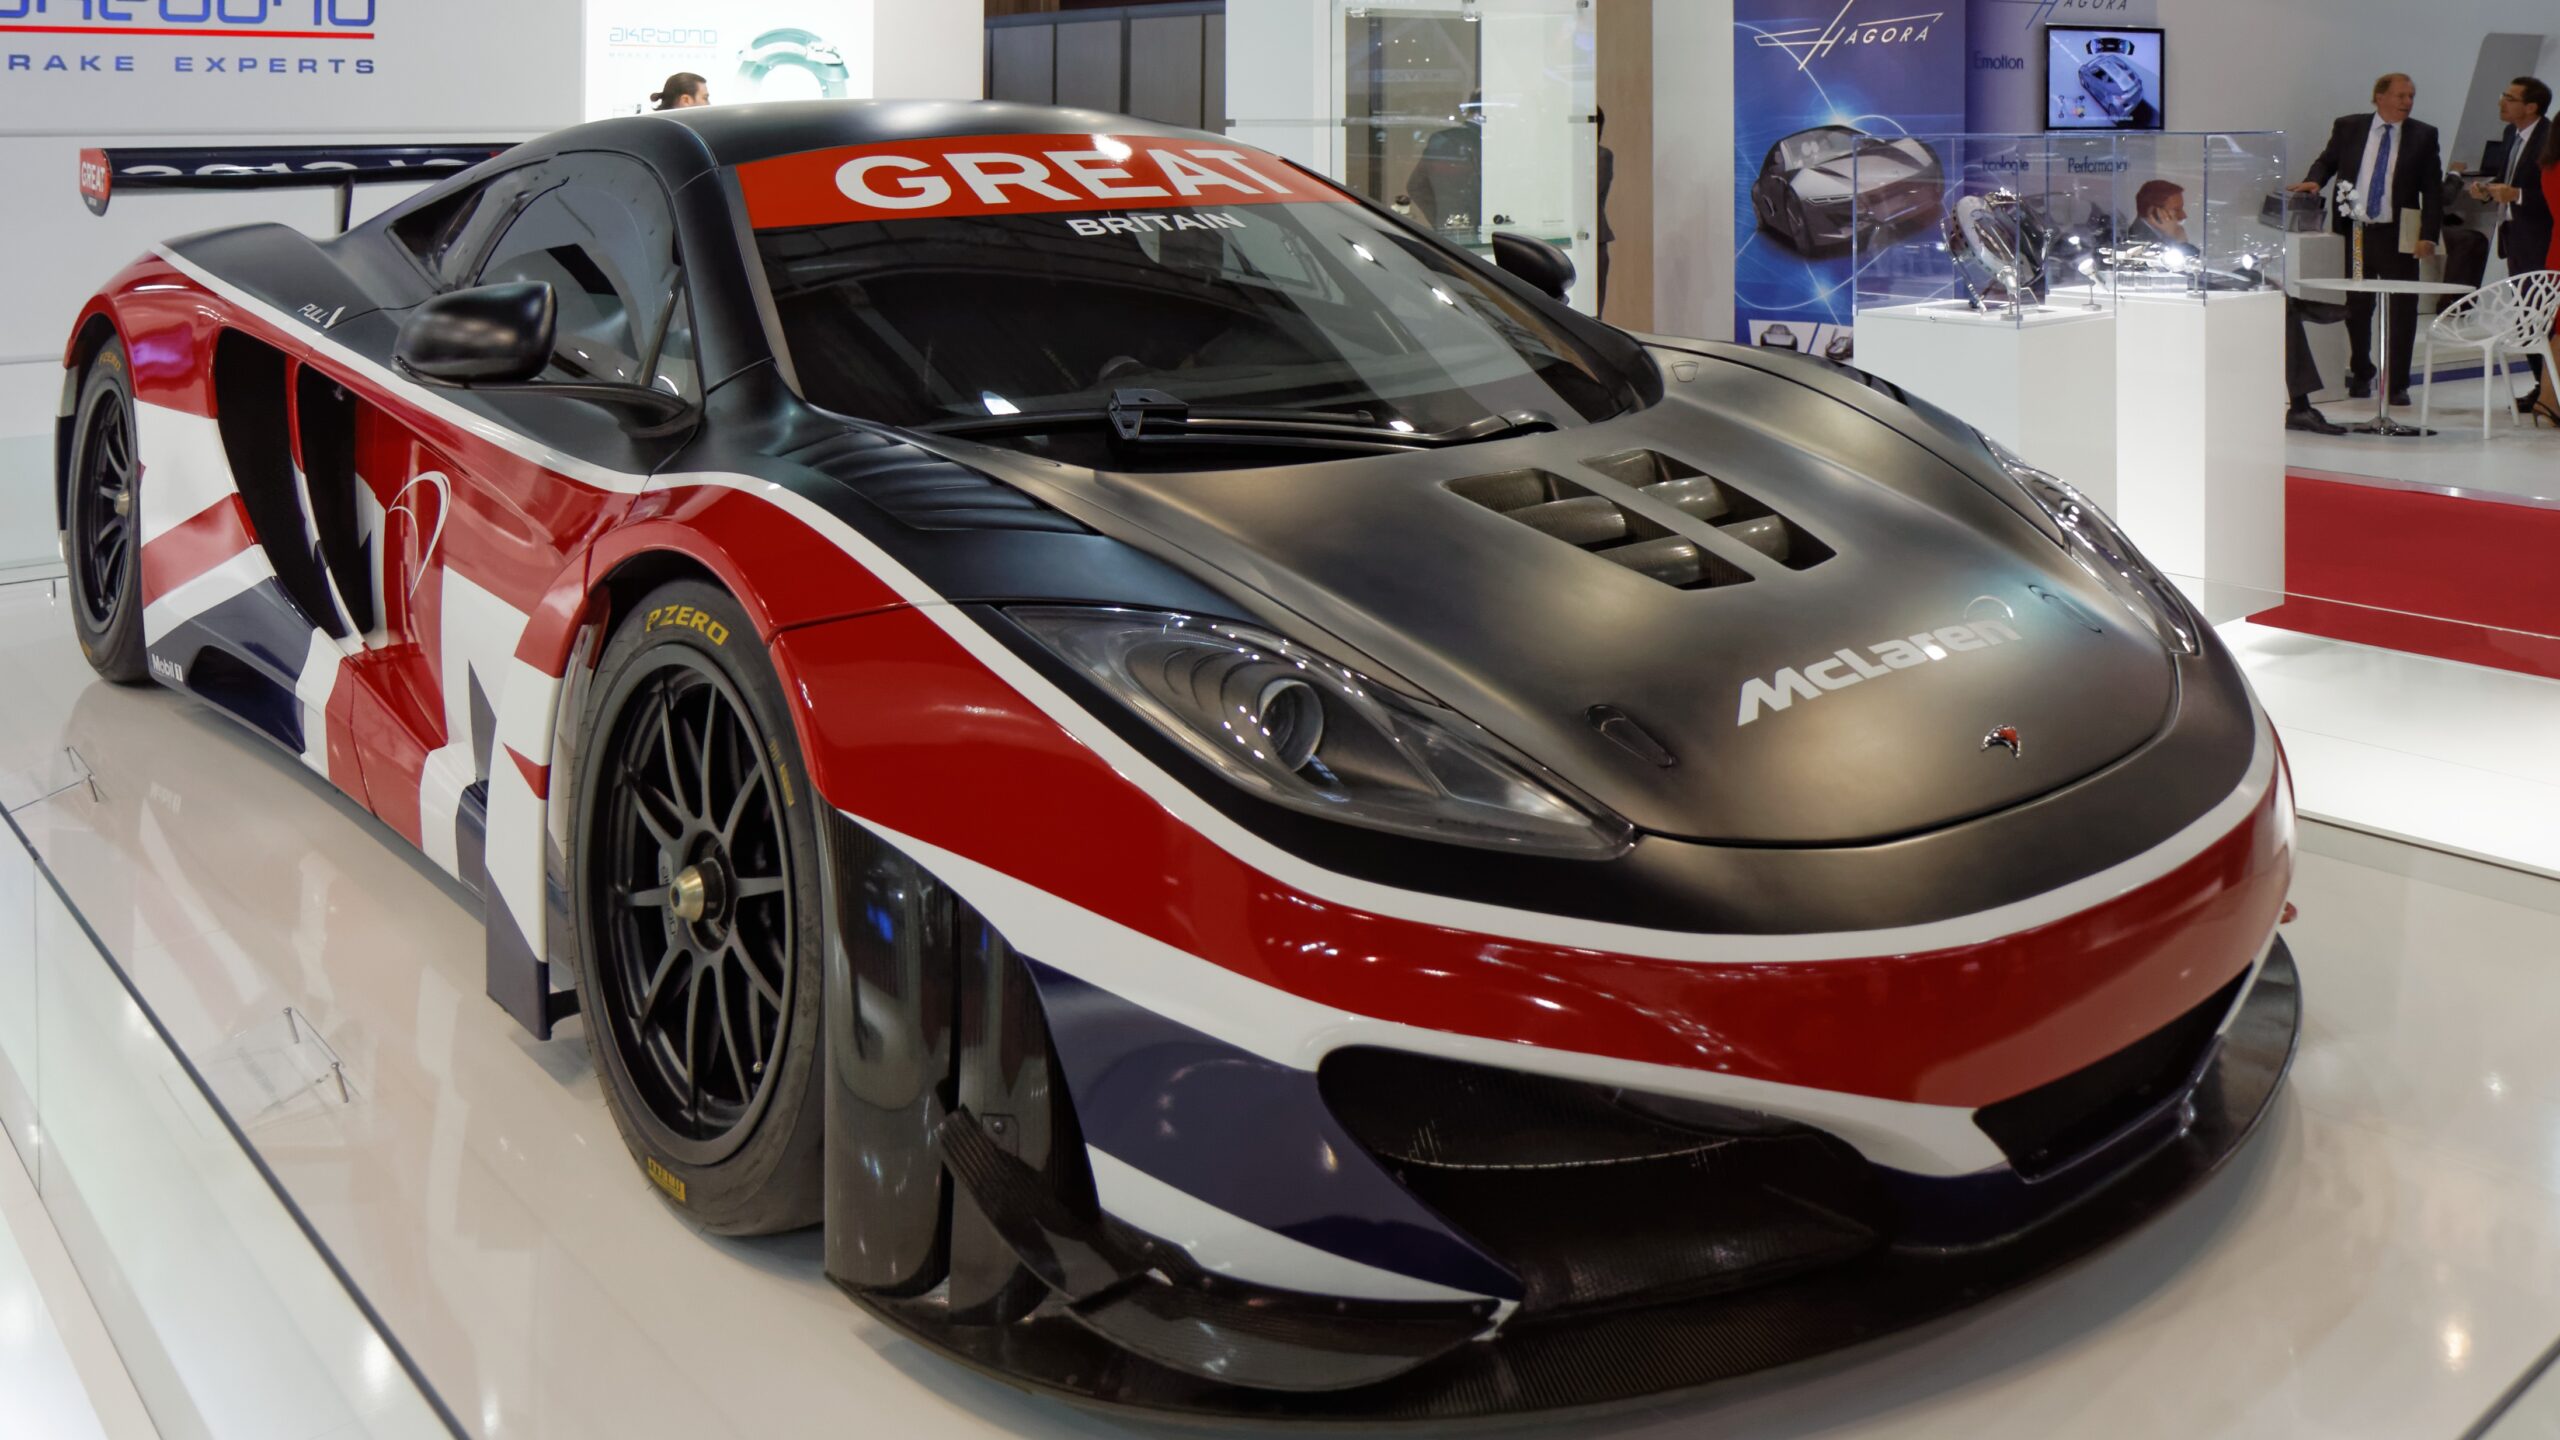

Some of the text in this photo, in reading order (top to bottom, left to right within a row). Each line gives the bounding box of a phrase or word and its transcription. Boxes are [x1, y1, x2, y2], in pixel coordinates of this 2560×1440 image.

[609, 27, 718, 44] akebono
[174, 56, 375, 75] EXPERTS
[1974, 50, 2024, 70] Emotion
[81, 160, 106, 193] GREAT
[834, 149, 1294, 209] GREAT
[1066, 212, 1247, 237] BRITAIN
[297, 303, 328, 323] PULL
[659, 604, 730, 646] ZERO
[151, 653, 175, 679] Mobil
[1737, 620, 2023, 726] McLaren
